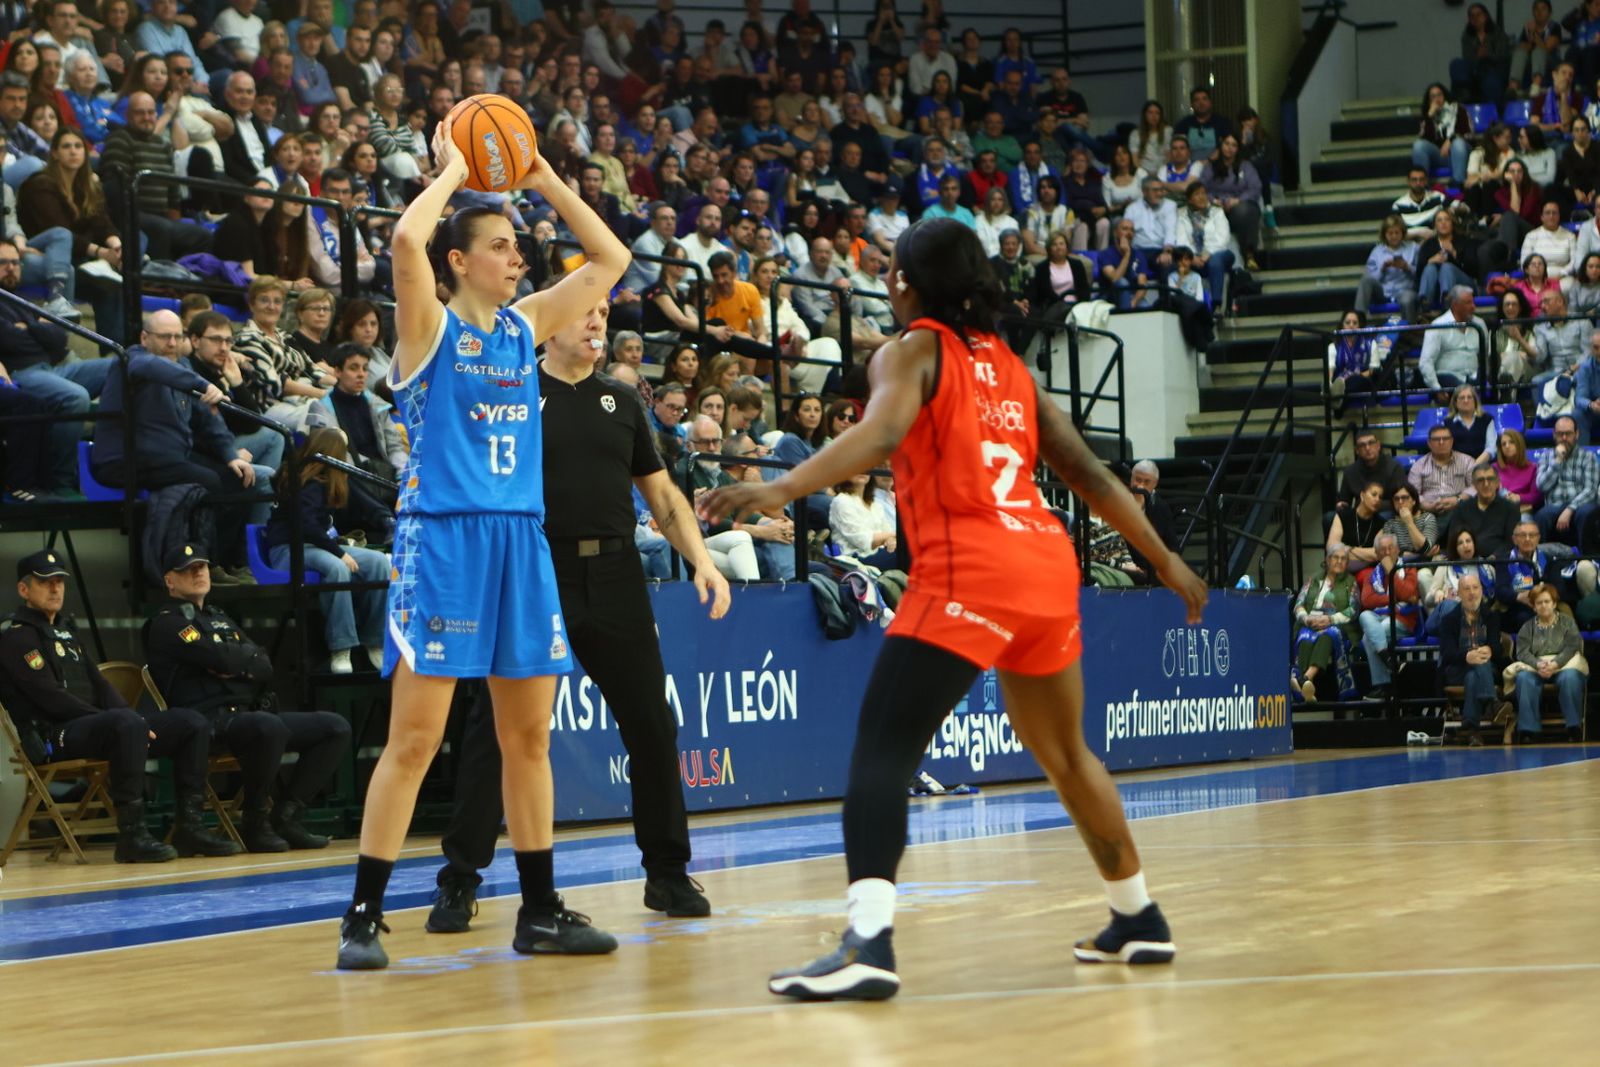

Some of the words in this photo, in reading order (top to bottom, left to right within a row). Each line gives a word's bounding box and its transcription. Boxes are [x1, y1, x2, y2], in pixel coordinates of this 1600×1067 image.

[488, 435, 517, 475] 13
[981, 439, 1032, 508] 2
[699, 672, 714, 738] Y
[724, 650, 798, 723] LEÓN
[1106, 684, 1287, 752] perfumeriasavenida.com
